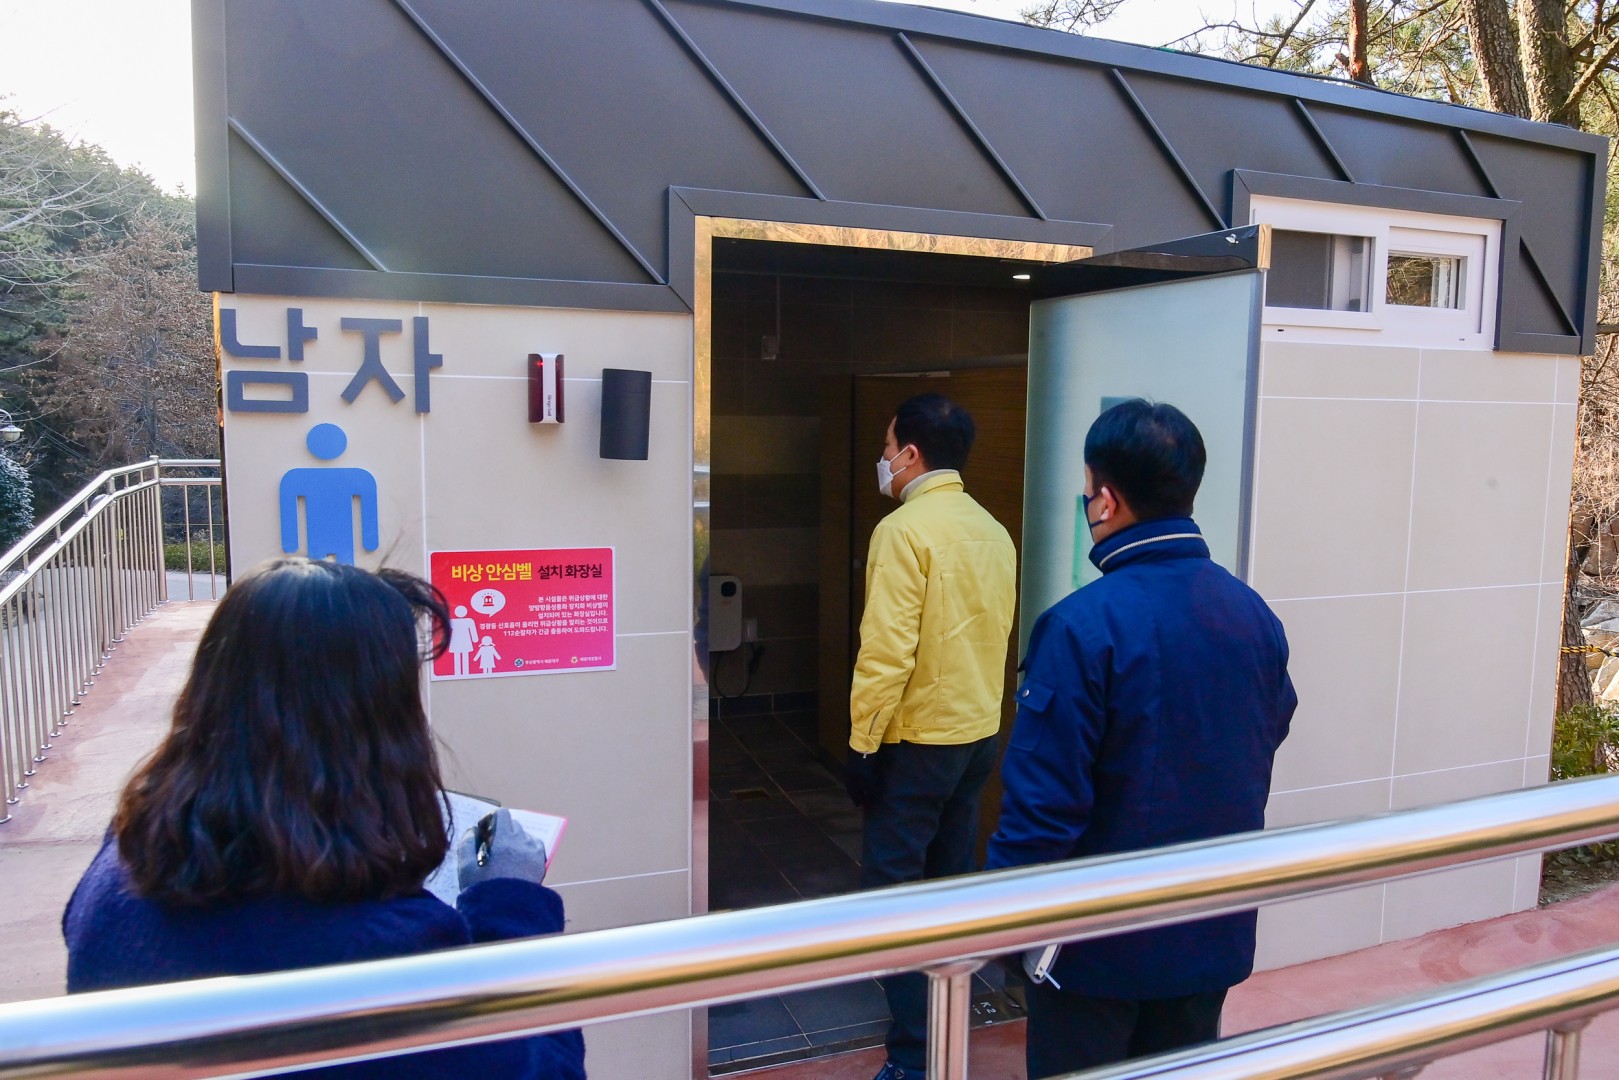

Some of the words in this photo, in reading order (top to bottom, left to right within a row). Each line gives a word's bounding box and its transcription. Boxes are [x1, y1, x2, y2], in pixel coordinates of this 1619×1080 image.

[220, 308, 443, 413] 남자
[451, 563, 483, 582] 비상
[486, 562, 533, 581] 안심벨
[538, 564, 562, 580] 설치
[565, 563, 603, 579] 화장실
[568, 594, 596, 602] 위급상황에
[597, 593, 608, 601] 대한
[528, 603, 568, 611] 양방향음성통화
[586, 601, 608, 609] 비상벨이
[538, 611, 560, 619] 설치되어
[573, 610, 608, 618] 화장실입니다.
[479, 622, 497, 630] 경광등
[522, 620, 539, 628] 울리면
[540, 619, 568, 627] 위급상황을
[568, 618, 585, 626] 알리는
[586, 617, 608, 625] 것이므로
[503, 628, 537, 637] 112순찰차가
[538, 627, 549, 635] 긴급
[550, 627, 573, 635] 출동하여
[574, 625, 608, 633] 도와드립니다.
